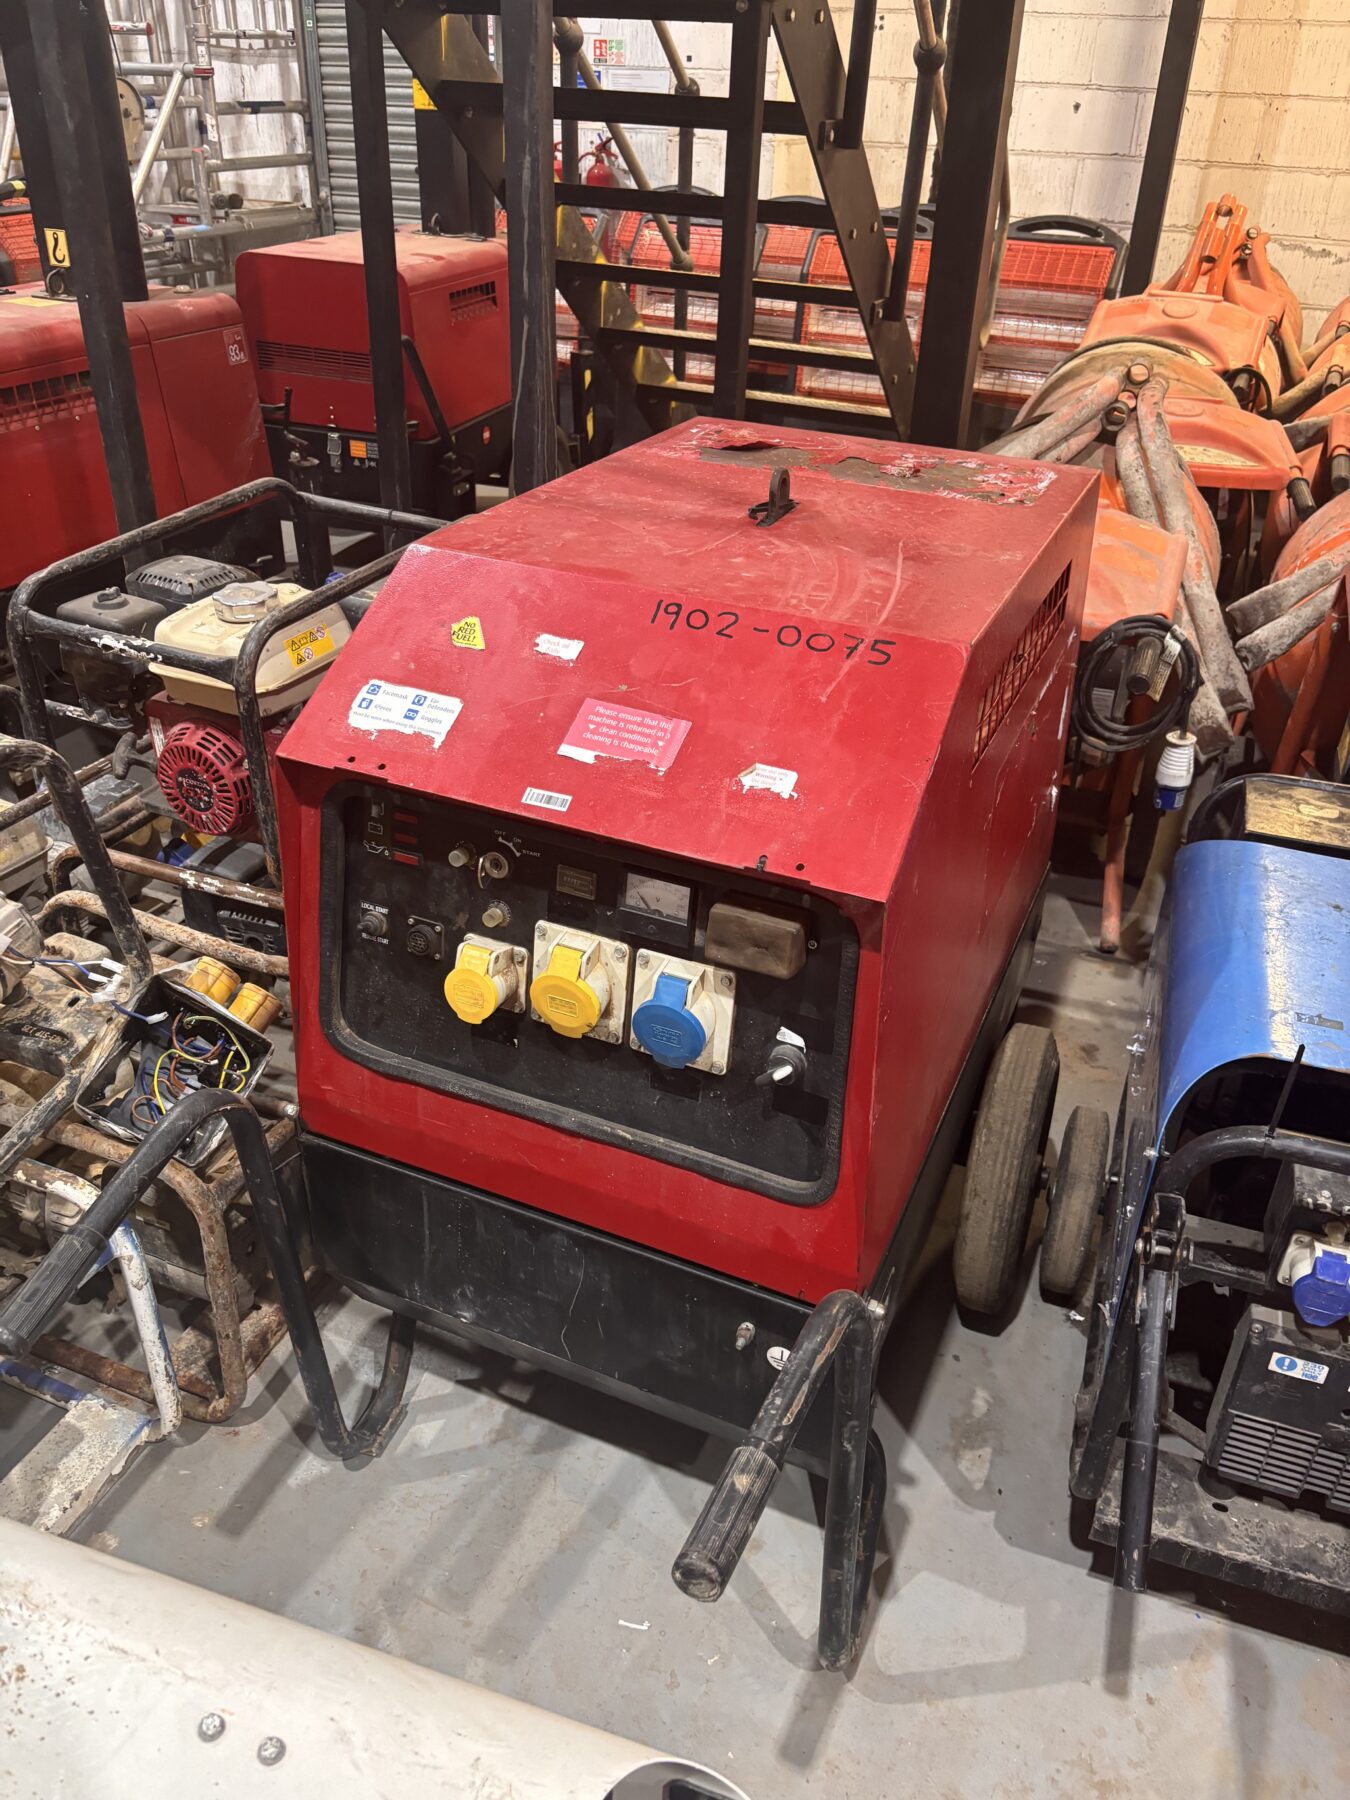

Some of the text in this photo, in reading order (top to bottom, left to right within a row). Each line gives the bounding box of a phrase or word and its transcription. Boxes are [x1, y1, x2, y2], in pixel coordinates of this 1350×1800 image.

[229, 344, 240, 362] 93
[458, 626, 476, 636] RED
[464, 621, 477, 629] NO
[452, 630, 477, 643] FUEL!
[650, 599, 897, 666] 1902-0075
[382, 689, 408, 701] Facemask
[427, 703, 455, 715] Defenders
[420, 714, 443, 725] Goggles
[595, 706, 673, 731] Please ensure that this
[588, 714, 618, 726] machine
[619, 720, 626, 728] is
[626, 724, 656, 736] returned
[599, 726, 652, 744] clean condition
[583, 732, 659, 756] cleaning is chargeable
[494, 829, 506, 837] OFF
[522, 849, 542, 858] START
[361, 901, 389, 915] LOCAL START
[377, 936, 389, 945] START
